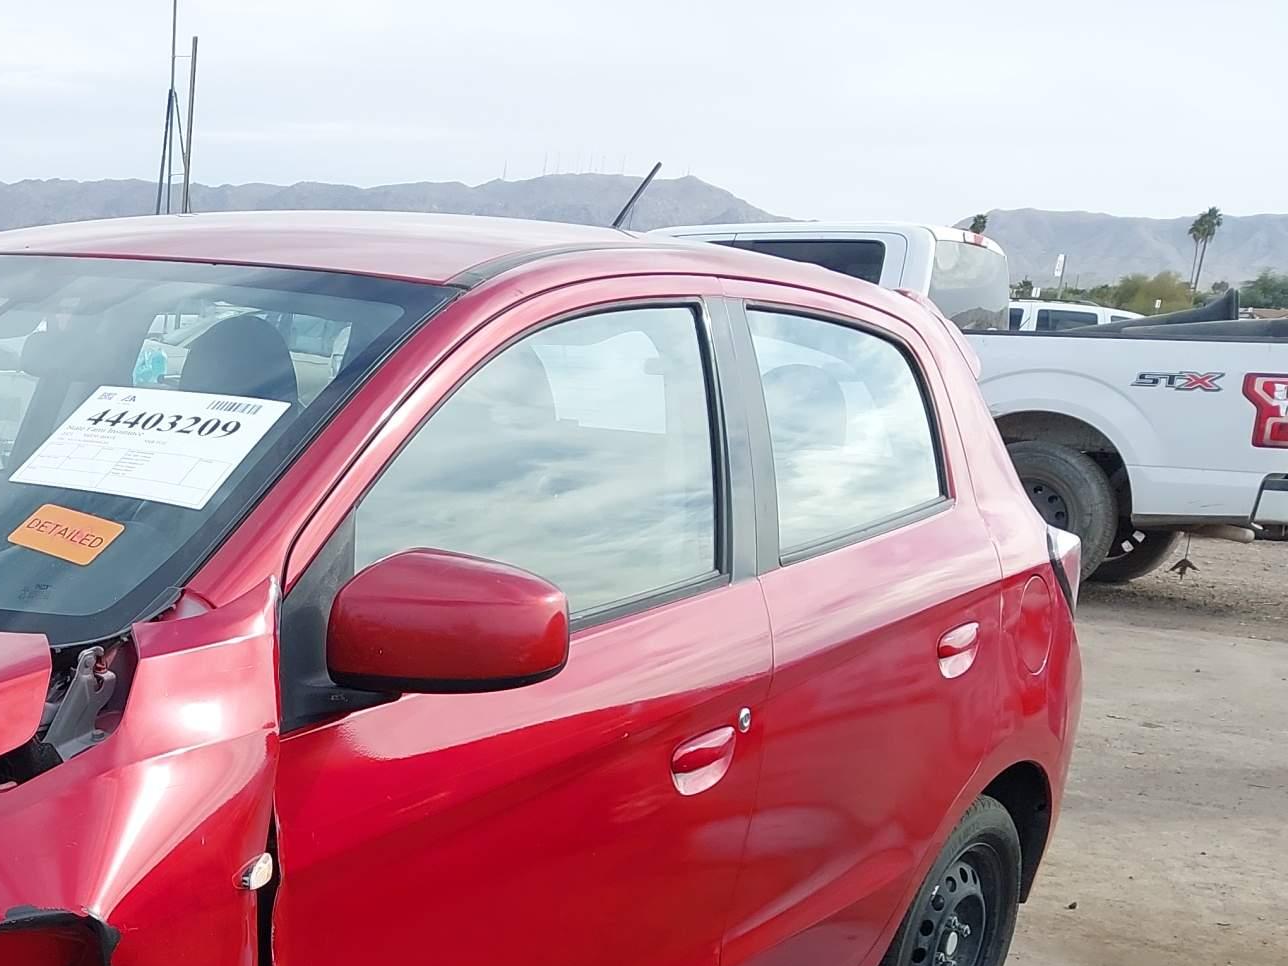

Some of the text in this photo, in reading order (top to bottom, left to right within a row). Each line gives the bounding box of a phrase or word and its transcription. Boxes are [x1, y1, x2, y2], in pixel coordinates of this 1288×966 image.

[1131, 371, 1225, 391] STX
[87, 408, 241, 439] 44403209
[26, 518, 104, 548] DETAILED
